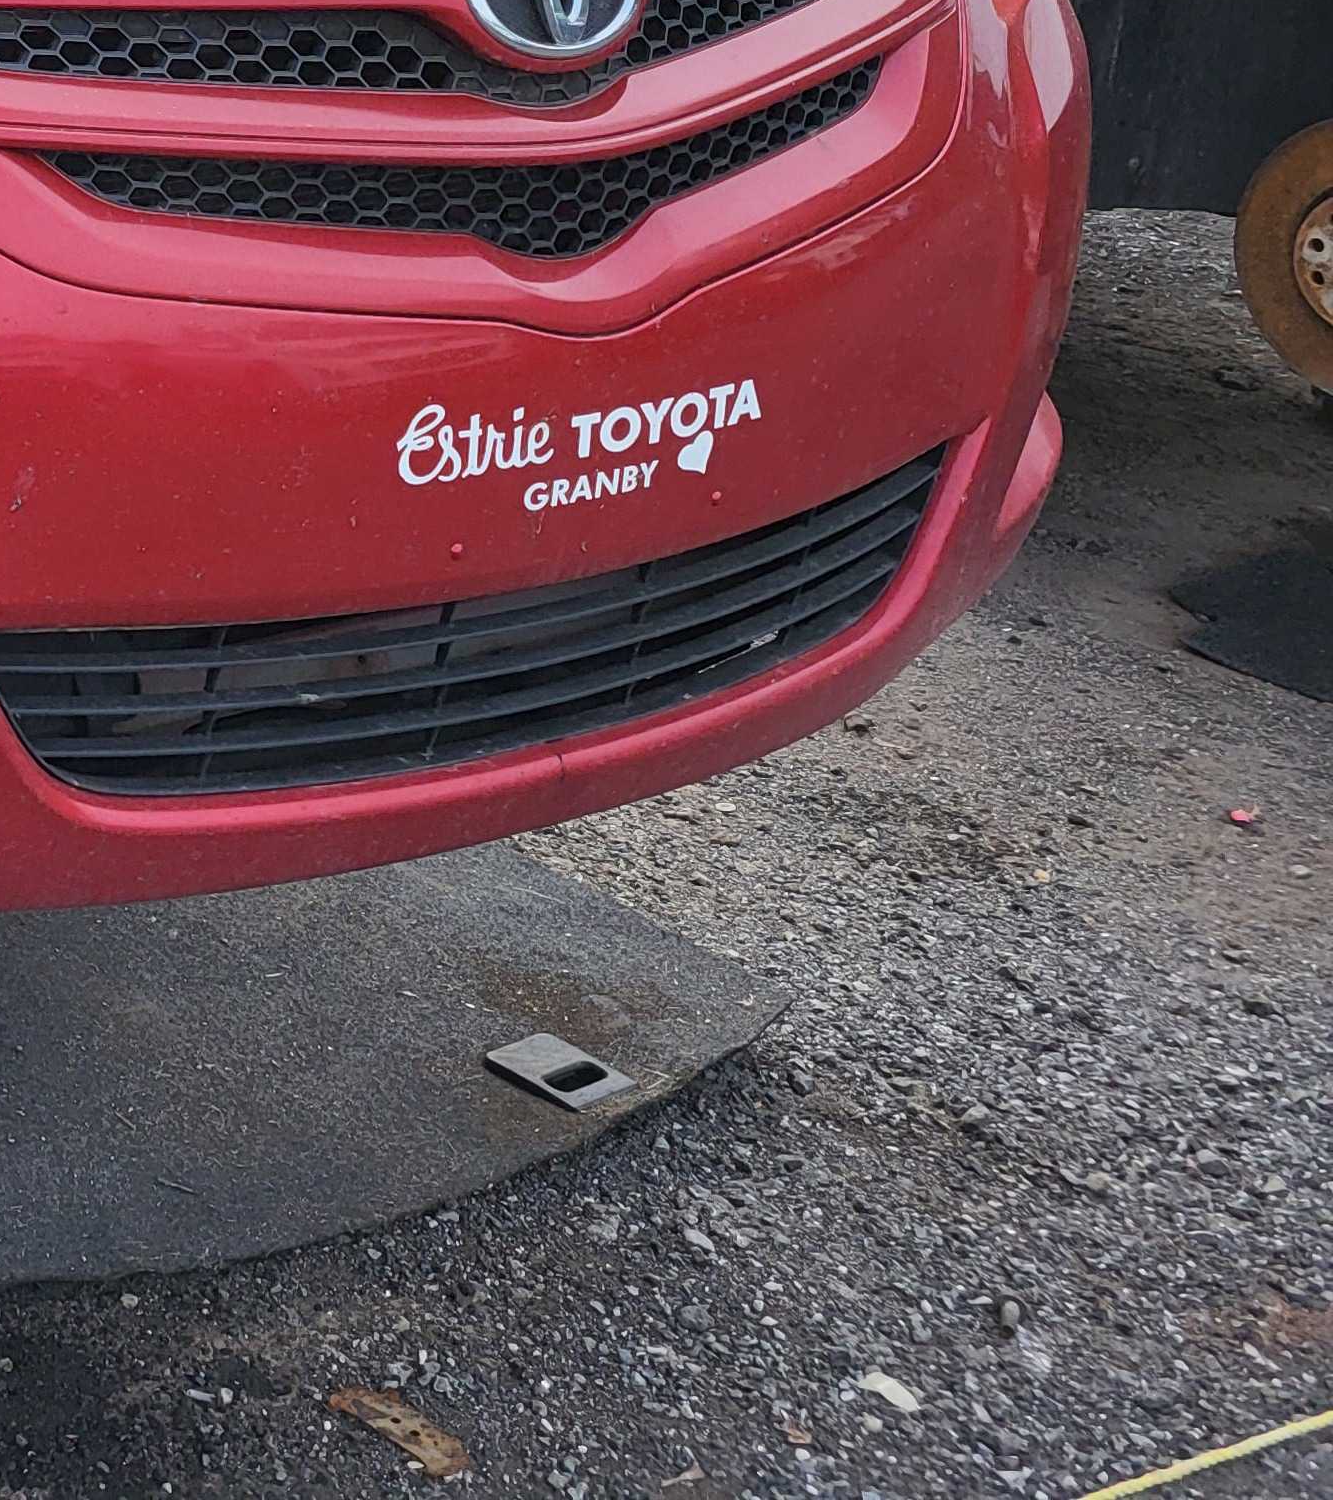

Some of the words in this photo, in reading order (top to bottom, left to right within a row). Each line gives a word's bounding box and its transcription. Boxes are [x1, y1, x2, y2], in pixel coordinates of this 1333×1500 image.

[396, 403, 555, 486] Estrie
[570, 378, 763, 459] TOYOTA
[522, 459, 660, 512] GRANBY
